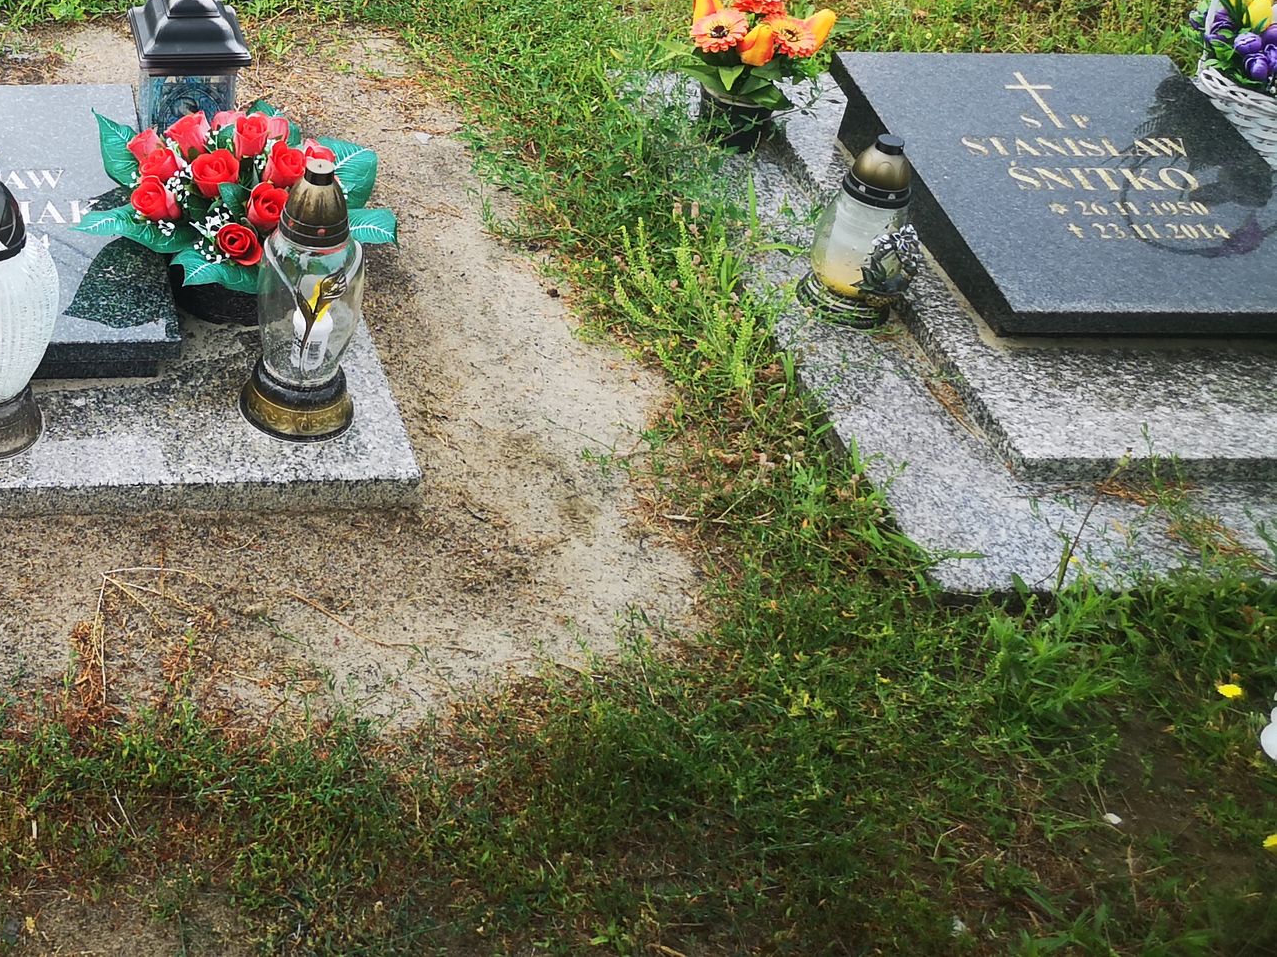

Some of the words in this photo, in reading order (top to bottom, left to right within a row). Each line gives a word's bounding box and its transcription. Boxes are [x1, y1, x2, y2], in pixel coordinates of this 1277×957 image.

[961, 136, 1188, 157] STANISŁAW
[1007, 160, 1199, 191] ŚNITKO
[1074, 201, 1209, 216] 26.11.1950
[1091, 223, 1231, 239] 23.11.2014
